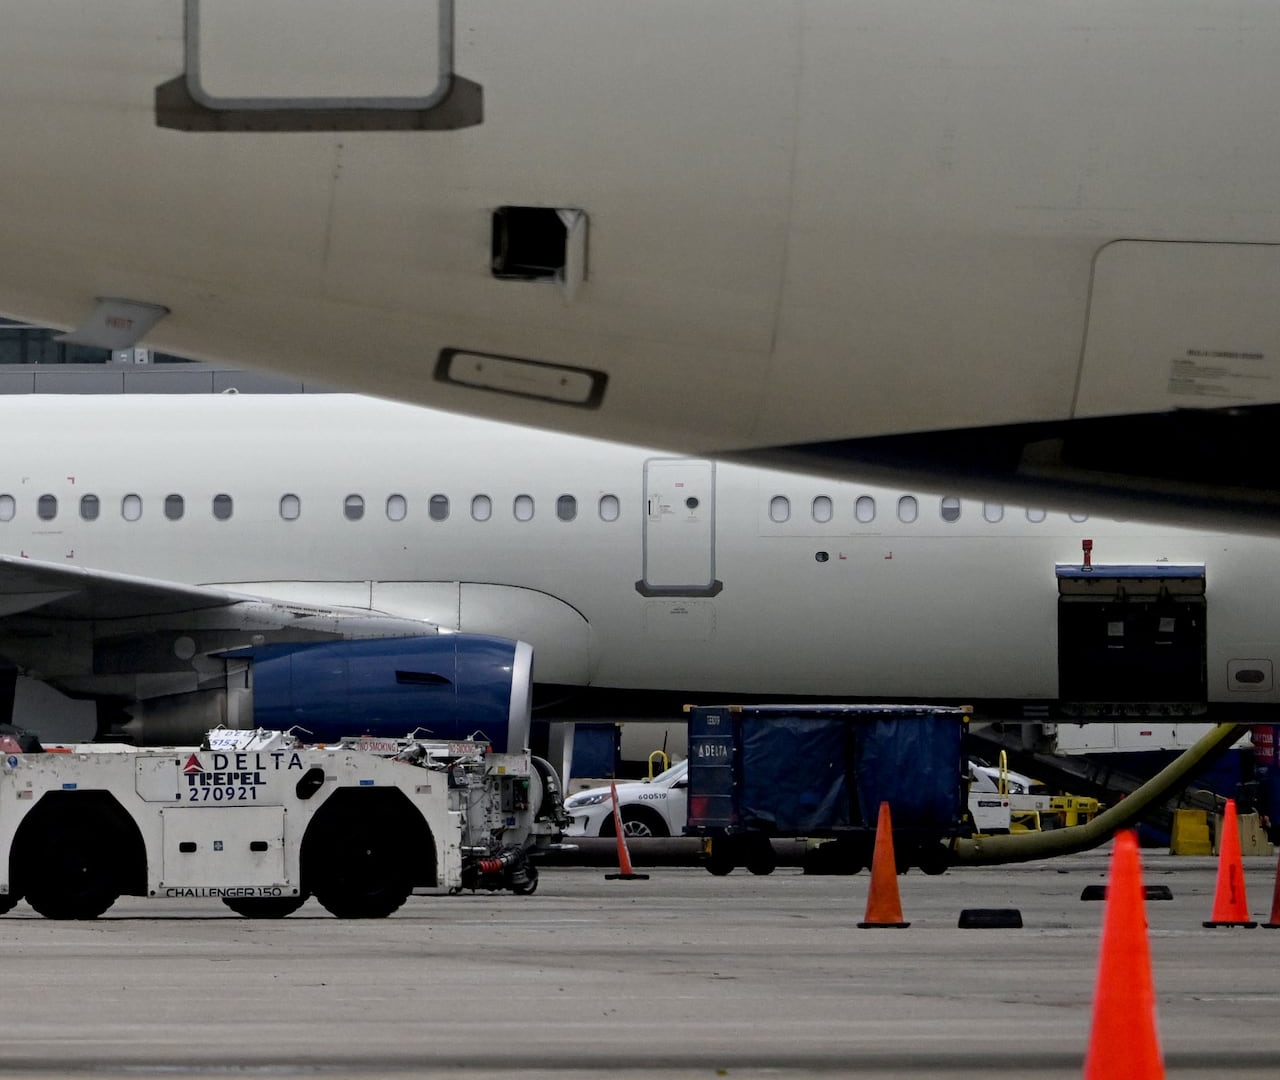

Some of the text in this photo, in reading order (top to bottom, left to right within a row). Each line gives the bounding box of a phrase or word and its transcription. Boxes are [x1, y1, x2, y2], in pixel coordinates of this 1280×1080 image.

[370, 742, 396, 752] SMOKING
[705, 745, 728, 757] DELTA
[214, 753, 303, 770] DELTA
[184, 772, 267, 786] TREPEL
[189, 786, 257, 801] 270921
[638, 792, 667, 800] 600519
[166, 887, 282, 898] CHALLENGER 150
